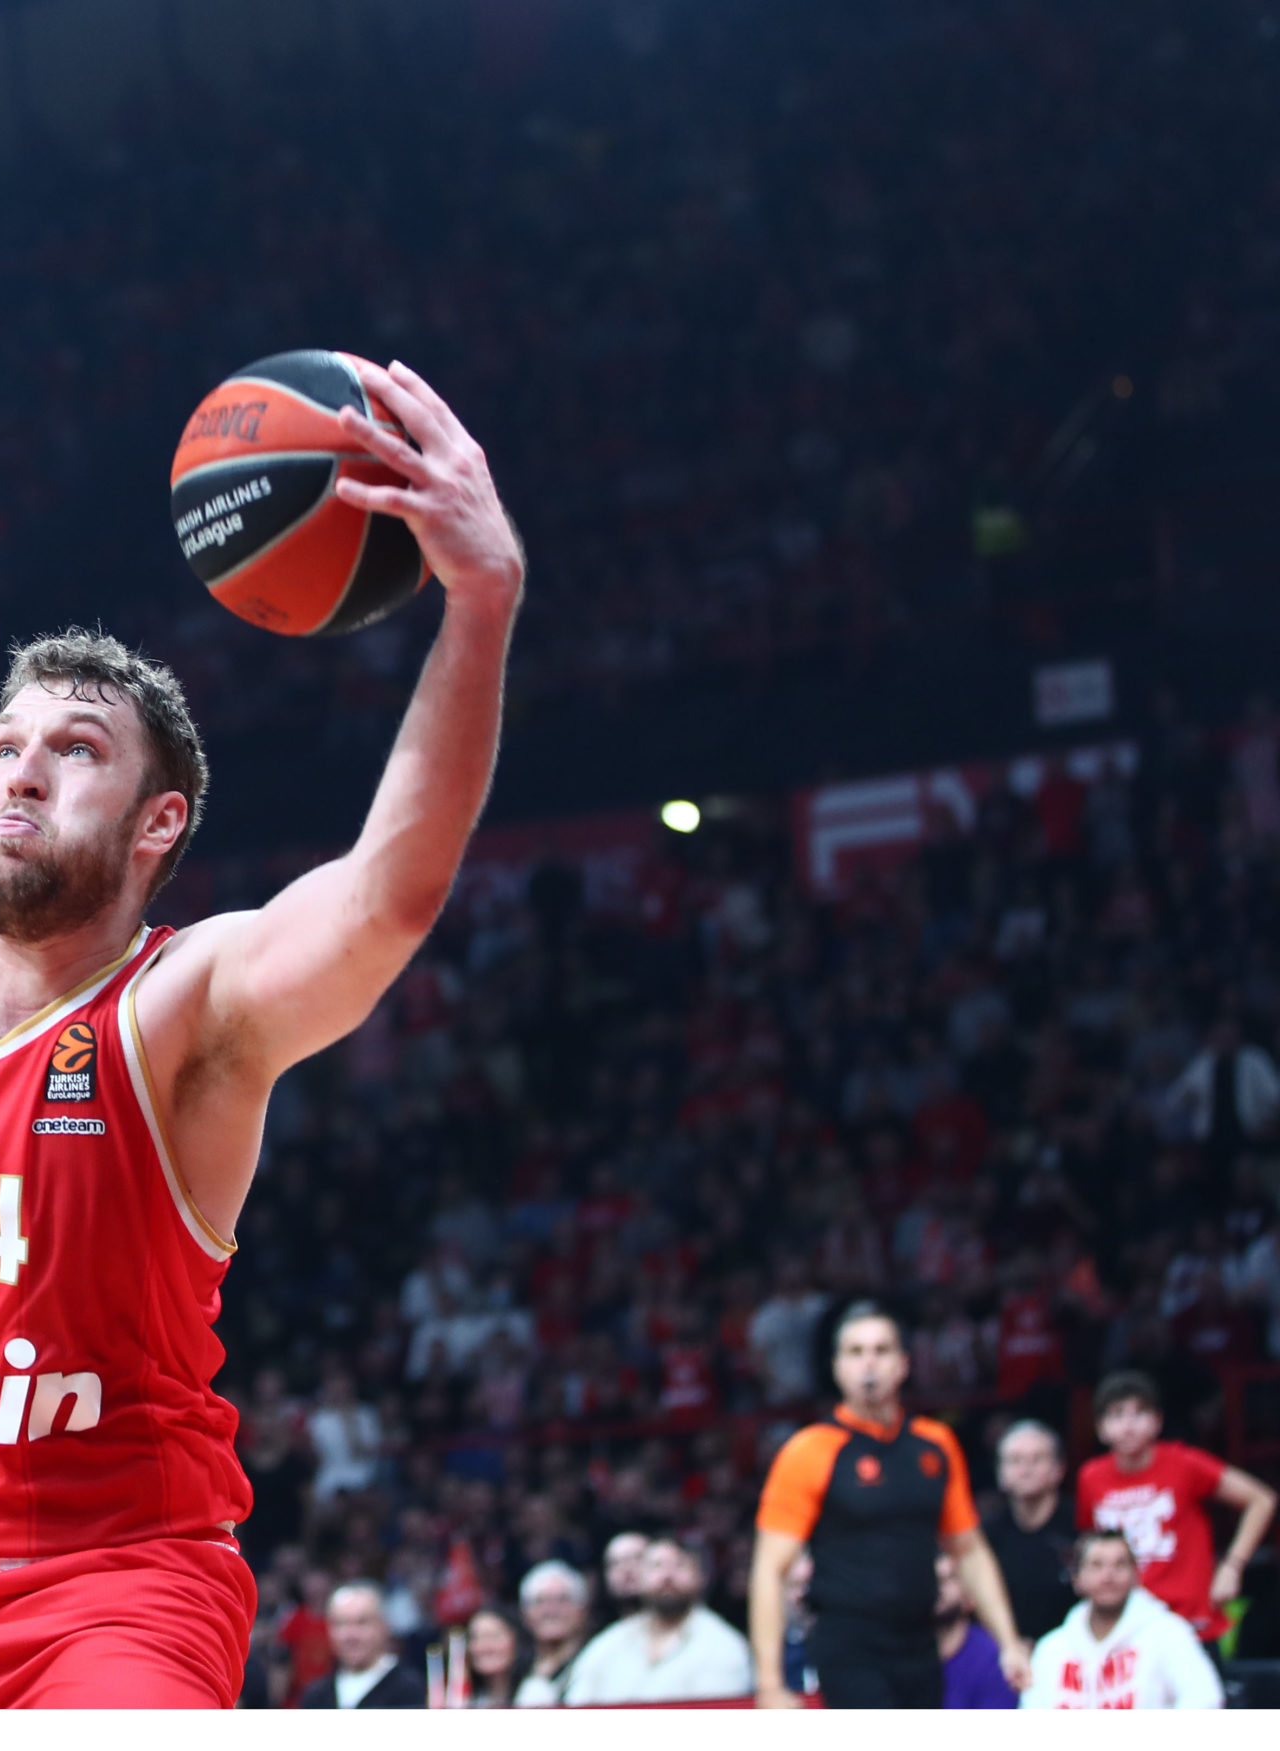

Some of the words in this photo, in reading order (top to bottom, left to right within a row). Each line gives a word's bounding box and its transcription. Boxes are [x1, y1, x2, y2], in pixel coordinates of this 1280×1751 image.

[204, 475, 272, 521] AIRLINES
[50, 1073, 90, 1084] TURKISH
[48, 1083, 90, 1092] AIRLINES
[47, 1091, 91, 1102] EuroLeague
[32, 1115, 105, 1135] oneteam
